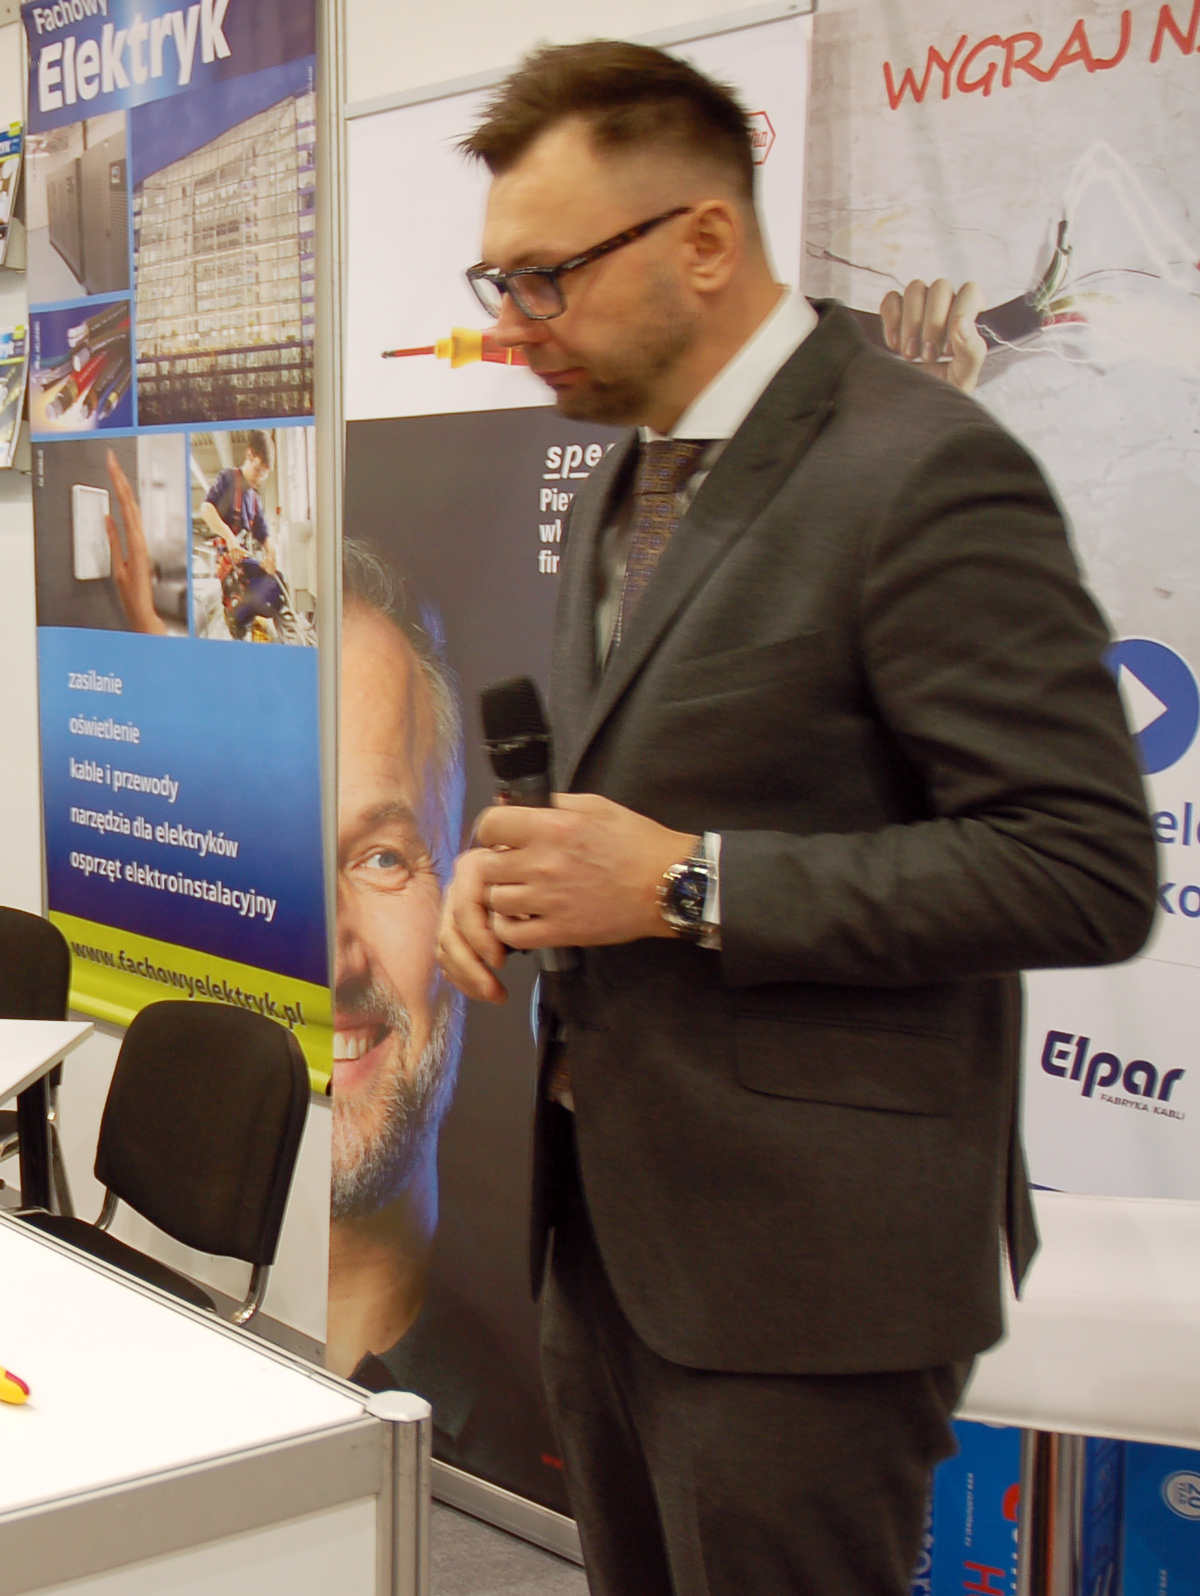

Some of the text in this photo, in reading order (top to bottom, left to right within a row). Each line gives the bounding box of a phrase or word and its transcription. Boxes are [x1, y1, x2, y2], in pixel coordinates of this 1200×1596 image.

[39, 0, 232, 113] Elektryk
[883, 0, 1200, 110] WYGRAJ N
[544, 443, 617, 479] spe
[540, 488, 574, 512] Pie
[68, 670, 123, 695] zasilanie
[68, 714, 141, 744] oświetlenie
[69, 757, 179, 804] kable i przewody
[70, 806, 239, 859] narzędzia dla elektryków
[1150, 801, 1200, 847] el
[70, 850, 277, 922] osprzęt elektroinstalacyjny
[71, 941, 307, 1030] www.fachowyelektryk.pl
[1041, 1029, 1186, 1102] Elpar
[1100, 1093, 1149, 1113] FABRYKA
[962, 1560, 1006, 1596] H
